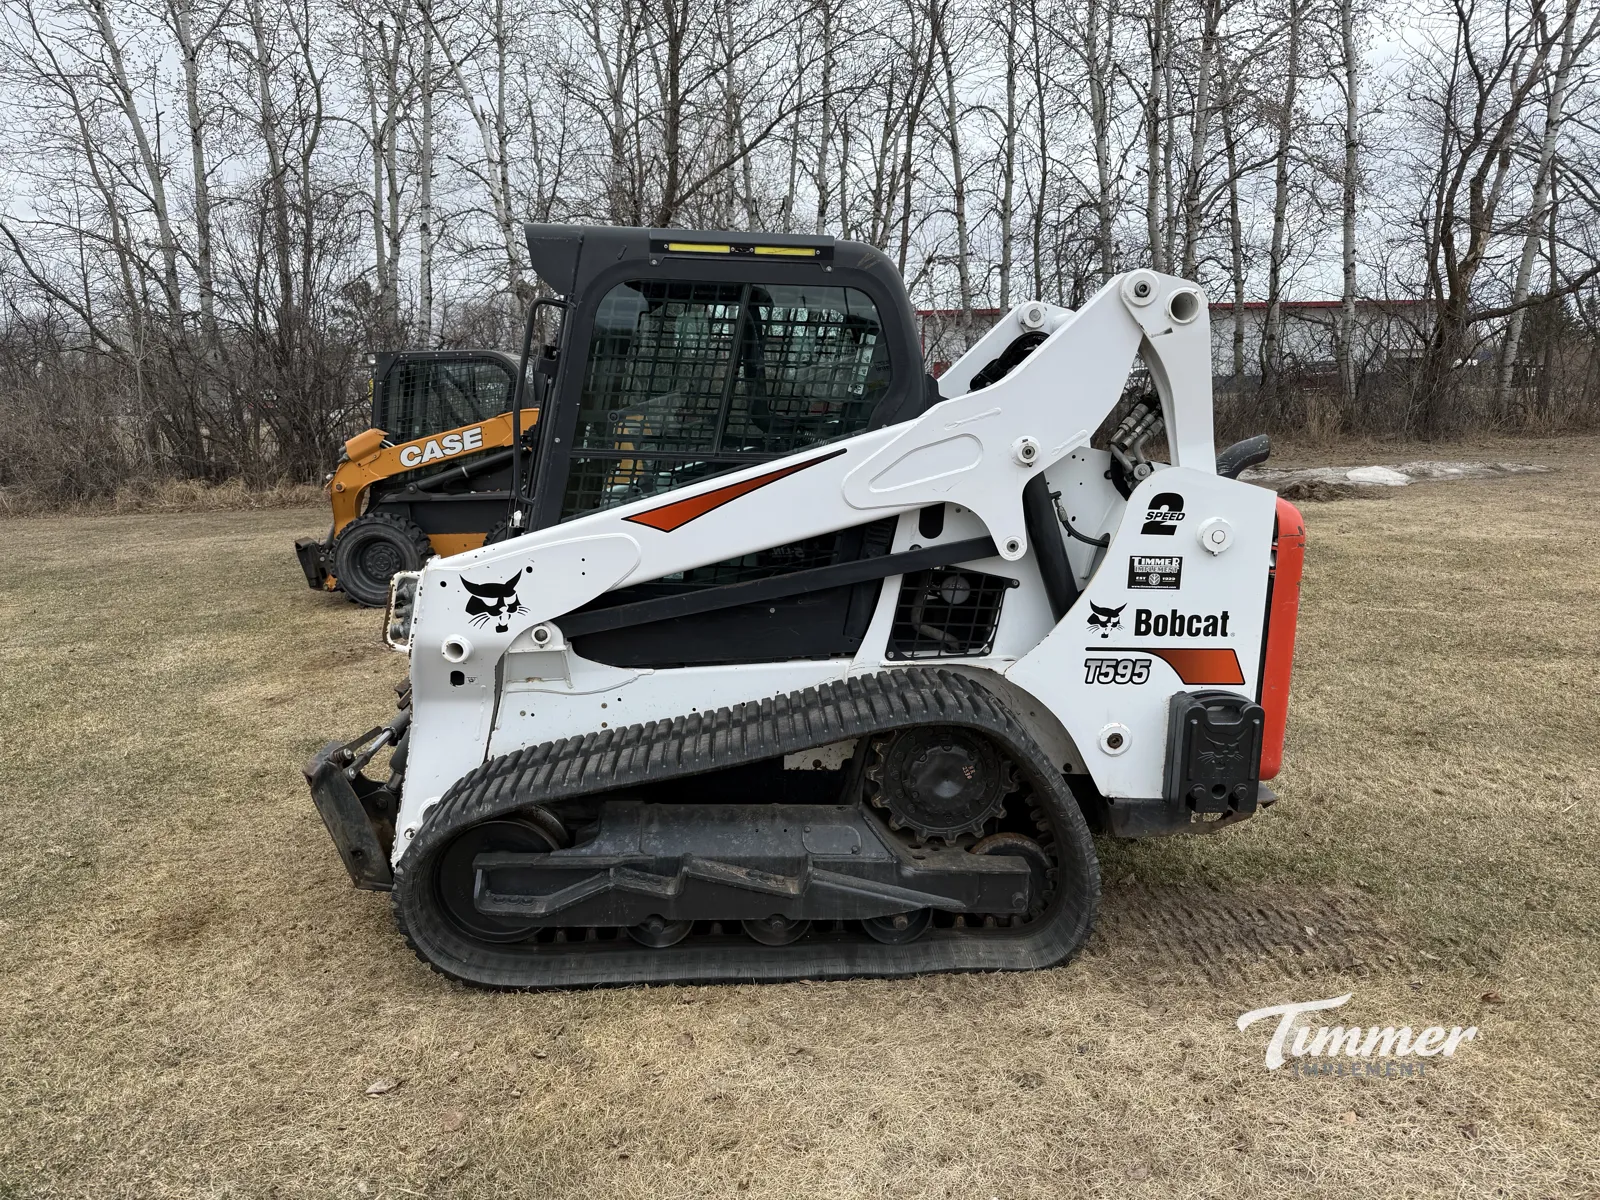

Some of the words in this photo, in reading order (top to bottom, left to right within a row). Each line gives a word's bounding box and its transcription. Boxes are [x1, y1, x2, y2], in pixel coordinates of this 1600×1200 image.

[400, 427, 483, 467] CASE
[1140, 492, 1184, 536] 2
[1145, 511, 1186, 521] SPEED
[1131, 556, 1180, 567] TIMMER
[1133, 565, 1179, 574] IMPLEMENT
[1134, 609, 1230, 637] Bobcat
[1084, 658, 1152, 685] T595
